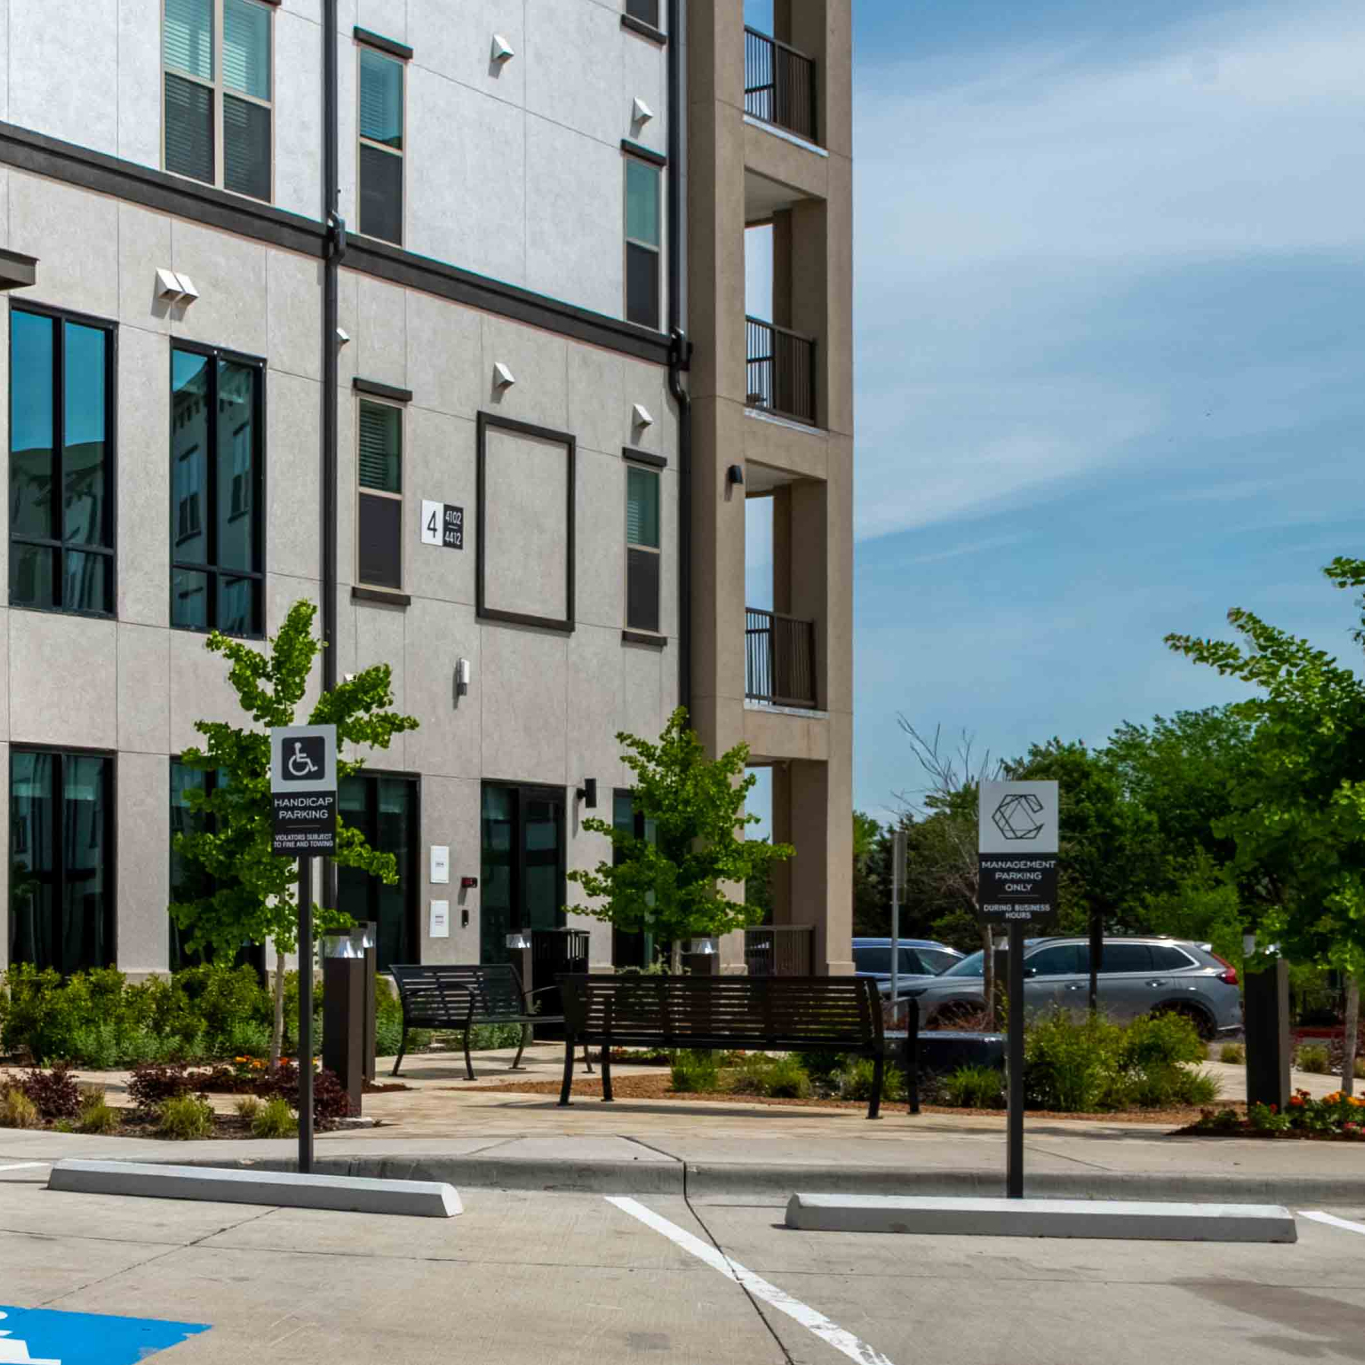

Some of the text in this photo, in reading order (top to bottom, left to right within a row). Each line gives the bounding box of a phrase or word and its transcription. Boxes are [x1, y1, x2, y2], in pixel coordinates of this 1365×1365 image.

[445, 510, 462, 525] 4102
[427, 510, 437, 539] 4
[444, 531, 462, 545] 4412
[274, 797, 334, 807] HANDICAP
[279, 809, 329, 820] PARKING
[981, 859, 1057, 869] MANAGEMENT
[995, 871, 1043, 881] PARKING
[1005, 883, 1033, 892] ONLY
[983, 904, 1051, 912] DURING BUSINESS
